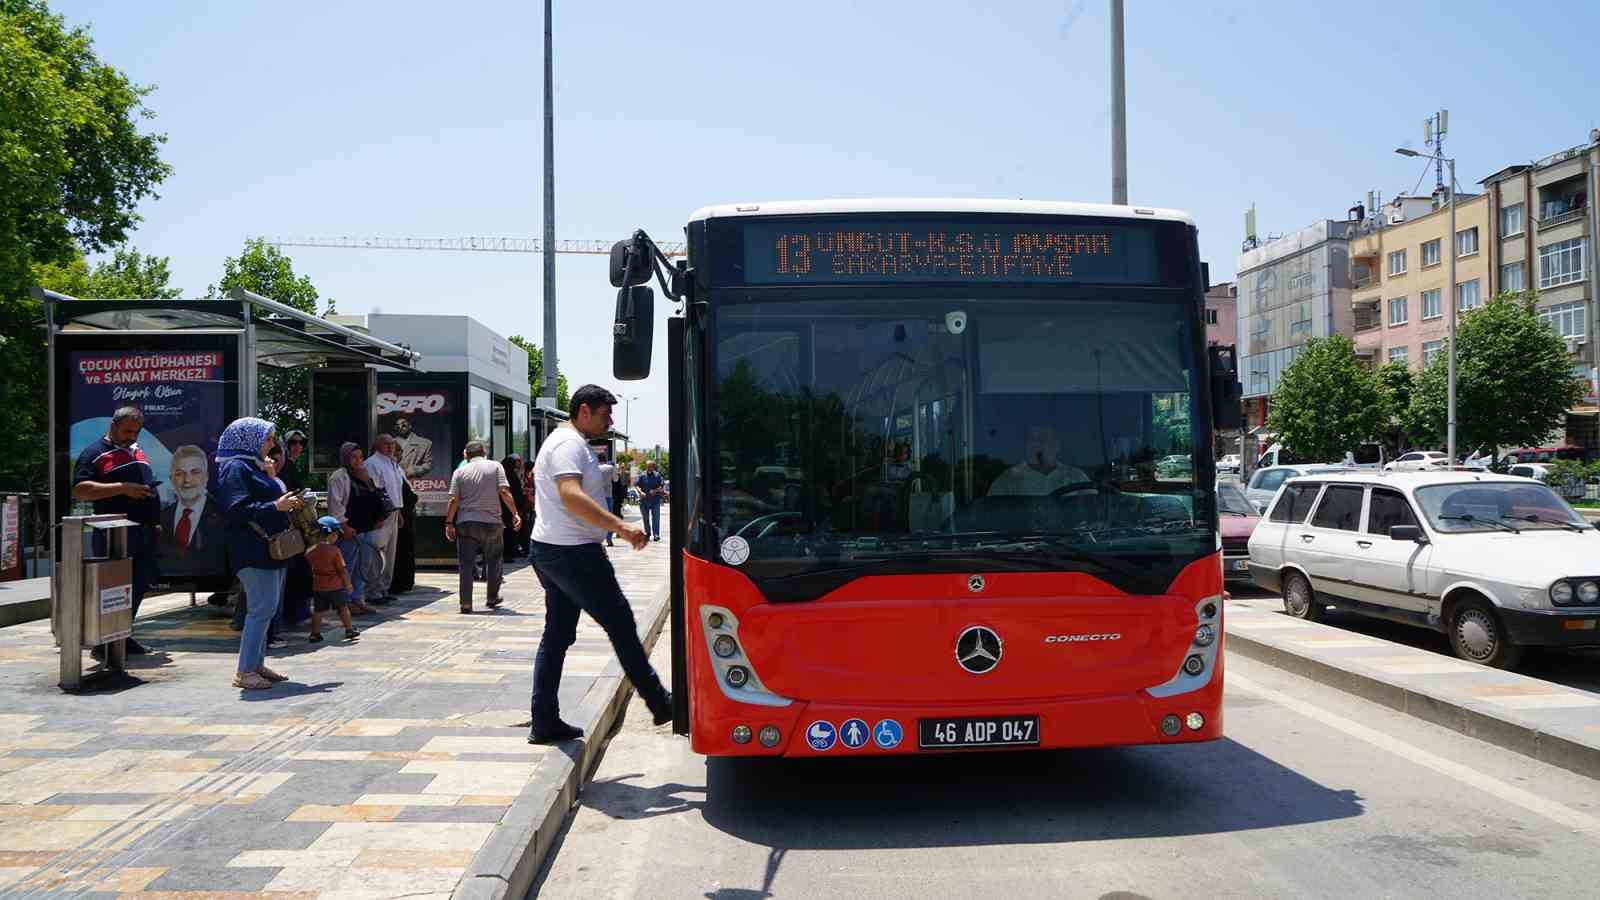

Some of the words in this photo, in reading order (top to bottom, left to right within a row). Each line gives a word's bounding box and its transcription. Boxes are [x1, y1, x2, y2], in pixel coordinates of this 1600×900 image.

[776, 233, 812, 273] 13
[79, 360, 122, 374] ÇOCUK
[86, 375, 101, 384] ve
[103, 371, 145, 384] SANAT
[376, 392, 445, 415] SEFO
[410, 479, 447, 491] RENA
[1044, 633, 1121, 643] CONECTO
[935, 722, 956, 743] 46
[964, 721, 997, 742] ADP
[1002, 720, 1034, 741] 047
